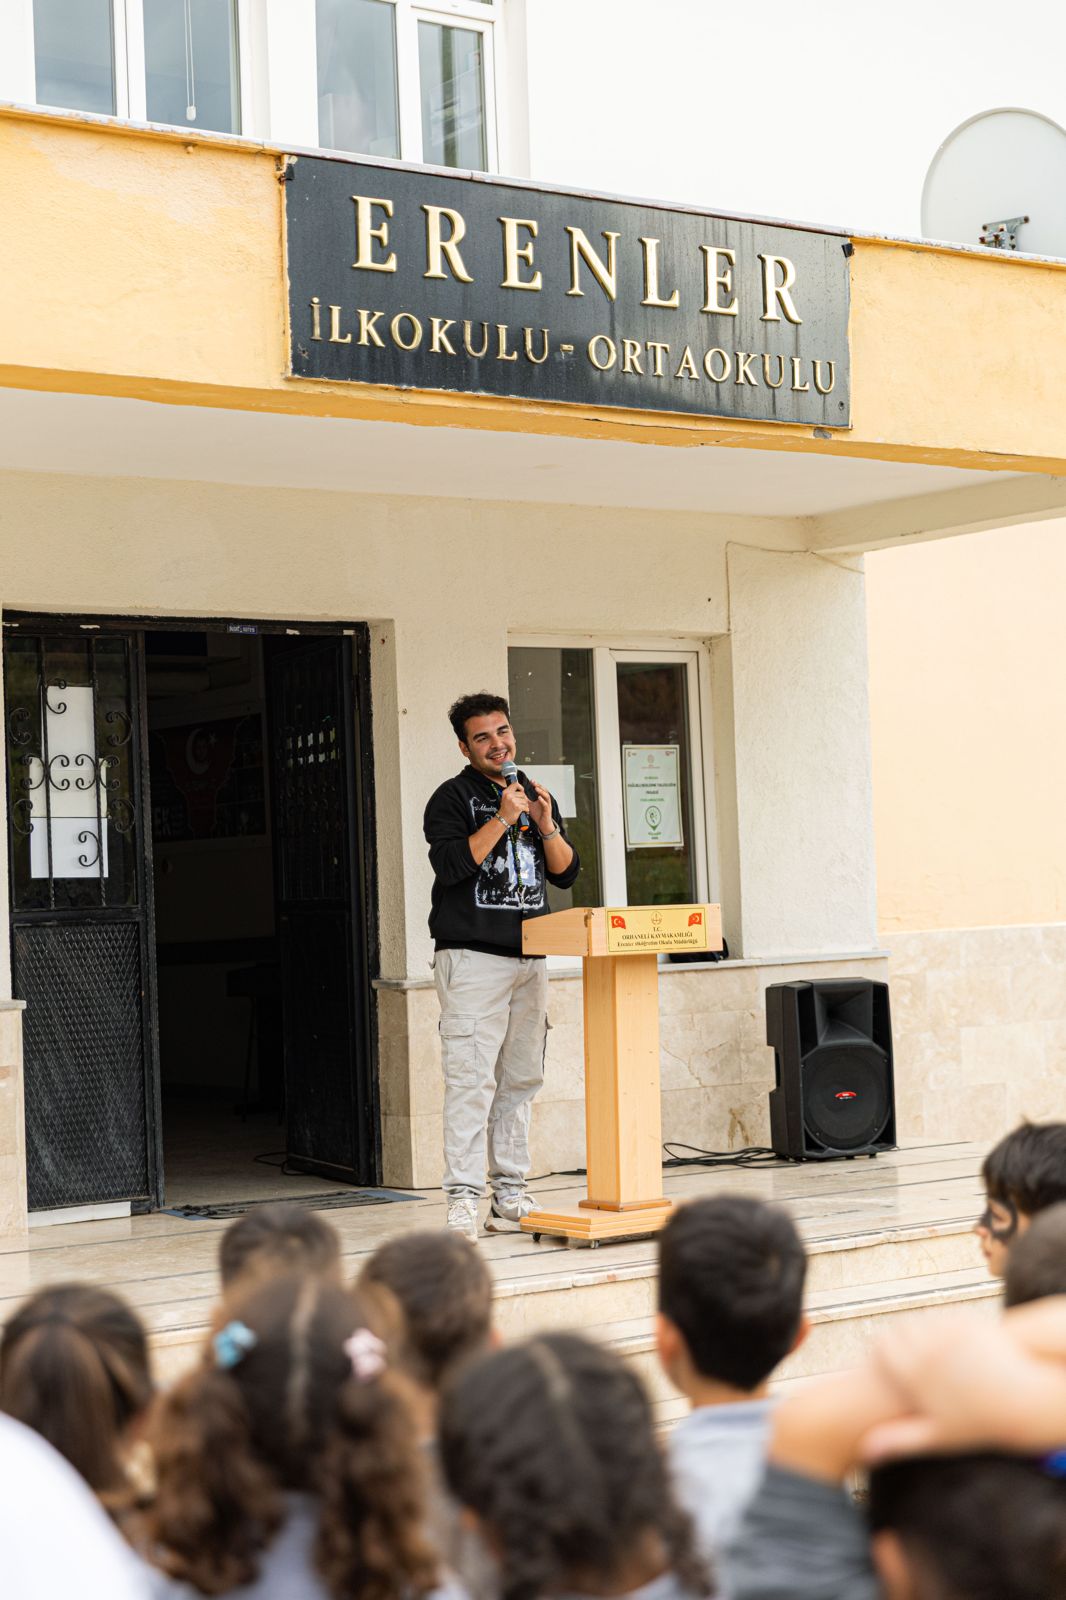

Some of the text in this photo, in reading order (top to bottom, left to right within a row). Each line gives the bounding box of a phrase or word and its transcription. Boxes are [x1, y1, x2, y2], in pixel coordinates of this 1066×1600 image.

[351, 195, 803, 325] ERENLER
[310, 297, 550, 364] İLKOKULU
[588, 334, 837, 394] ORTAOKULU
